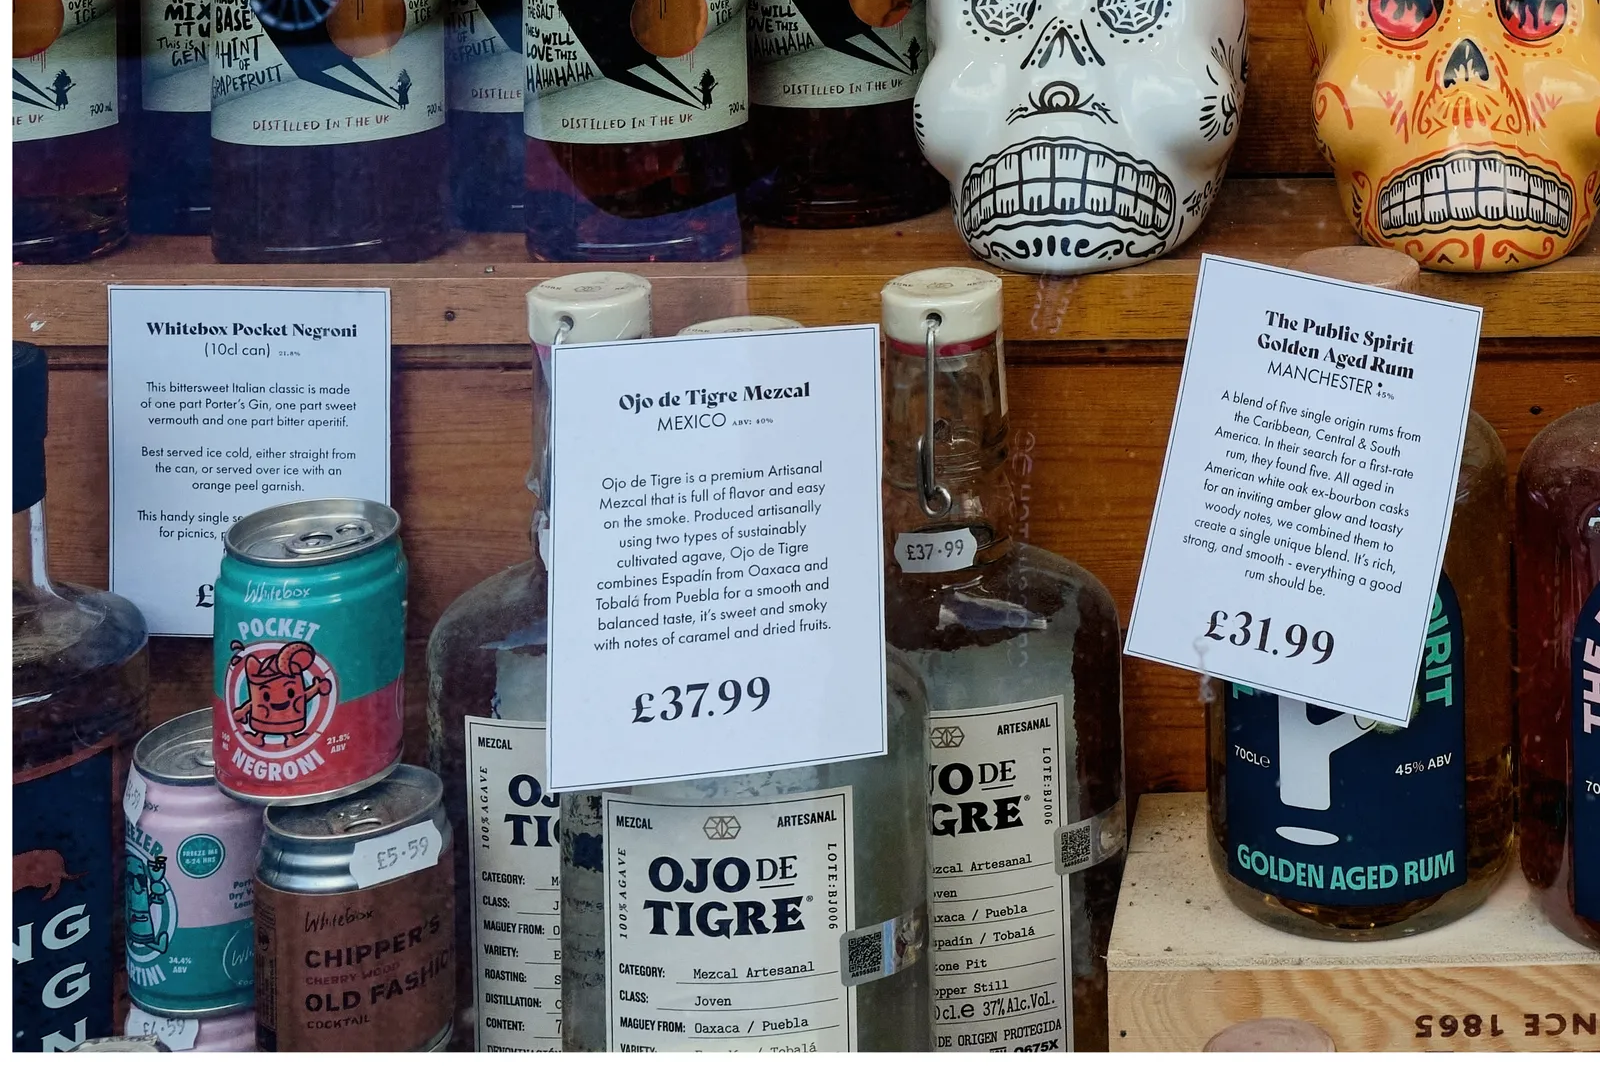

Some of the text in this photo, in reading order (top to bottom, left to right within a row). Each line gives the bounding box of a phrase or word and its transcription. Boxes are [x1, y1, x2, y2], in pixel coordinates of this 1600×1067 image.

[253, 119, 319, 131] DISTILLED
[347, 115, 369, 127] THE
[375, 114, 389, 124] UK
[147, 322, 357, 341] Whitebox Pocket Negroni
[1265, 310, 1414, 355] The Public Spirit
[1257, 334, 1414, 380] Golden Aged Rum
[170, 382, 304, 394] bittersweet Italian classic
[619, 382, 810, 414] Ojo de Tigre Mezcal
[657, 412, 727, 431] MEXICO
[711, 461, 822, 484] premium Artisanal
[238, 617, 320, 640] POCKET
[1205, 609, 1335, 666] £31.99
[632, 676, 771, 724] £37.99
[232, 749, 325, 782] NEGRONI
[616, 816, 652, 829] MEZCAL
[777, 810, 837, 828] ARTESANAL
[649, 855, 798, 893] OJO DE
[643, 896, 805, 940] TIGRE
[305, 914, 441, 969] CHIPPER'S
[619, 962, 815, 979] CATEGORY: Mezcal Artesanal
[1416, 1015, 1503, 1037] 1865
